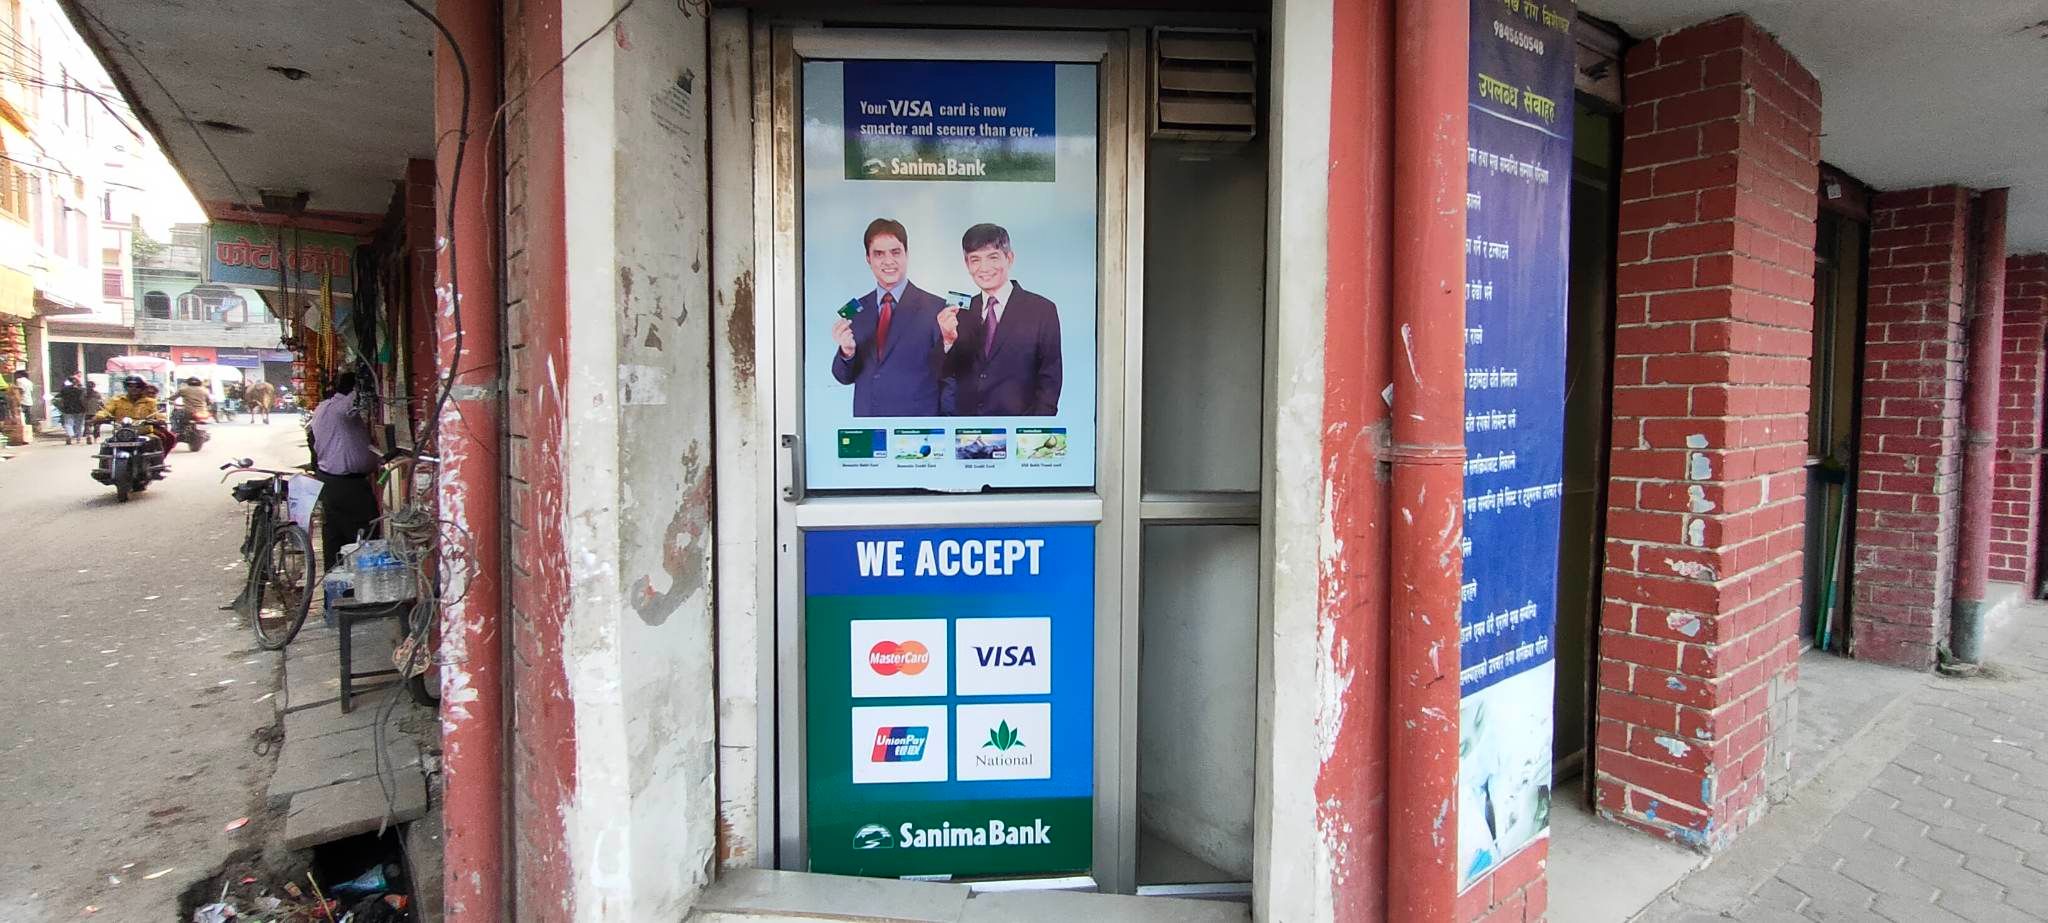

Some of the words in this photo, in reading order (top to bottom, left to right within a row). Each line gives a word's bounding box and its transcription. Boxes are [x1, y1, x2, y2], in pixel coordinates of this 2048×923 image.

[860, 100, 887, 116] Your
[888, 99, 933, 118] VISA
[940, 101, 966, 117] card
[969, 102, 980, 117] is
[983, 106, 1007, 118] now
[859, 123, 908, 136] smarter
[911, 122, 933, 137] and
[936, 124, 976, 137] secure
[979, 123, 1006, 137] than
[1009, 125, 1039, 138] ever.
[856, 540, 905, 577] WE
[914, 539, 1045, 577] ACCEPT
[869, 650, 929, 665] MasterCard
[971, 646, 1037, 667] VISA
[876, 734, 926, 747] UnionPay
[976, 753, 1033, 768] National
